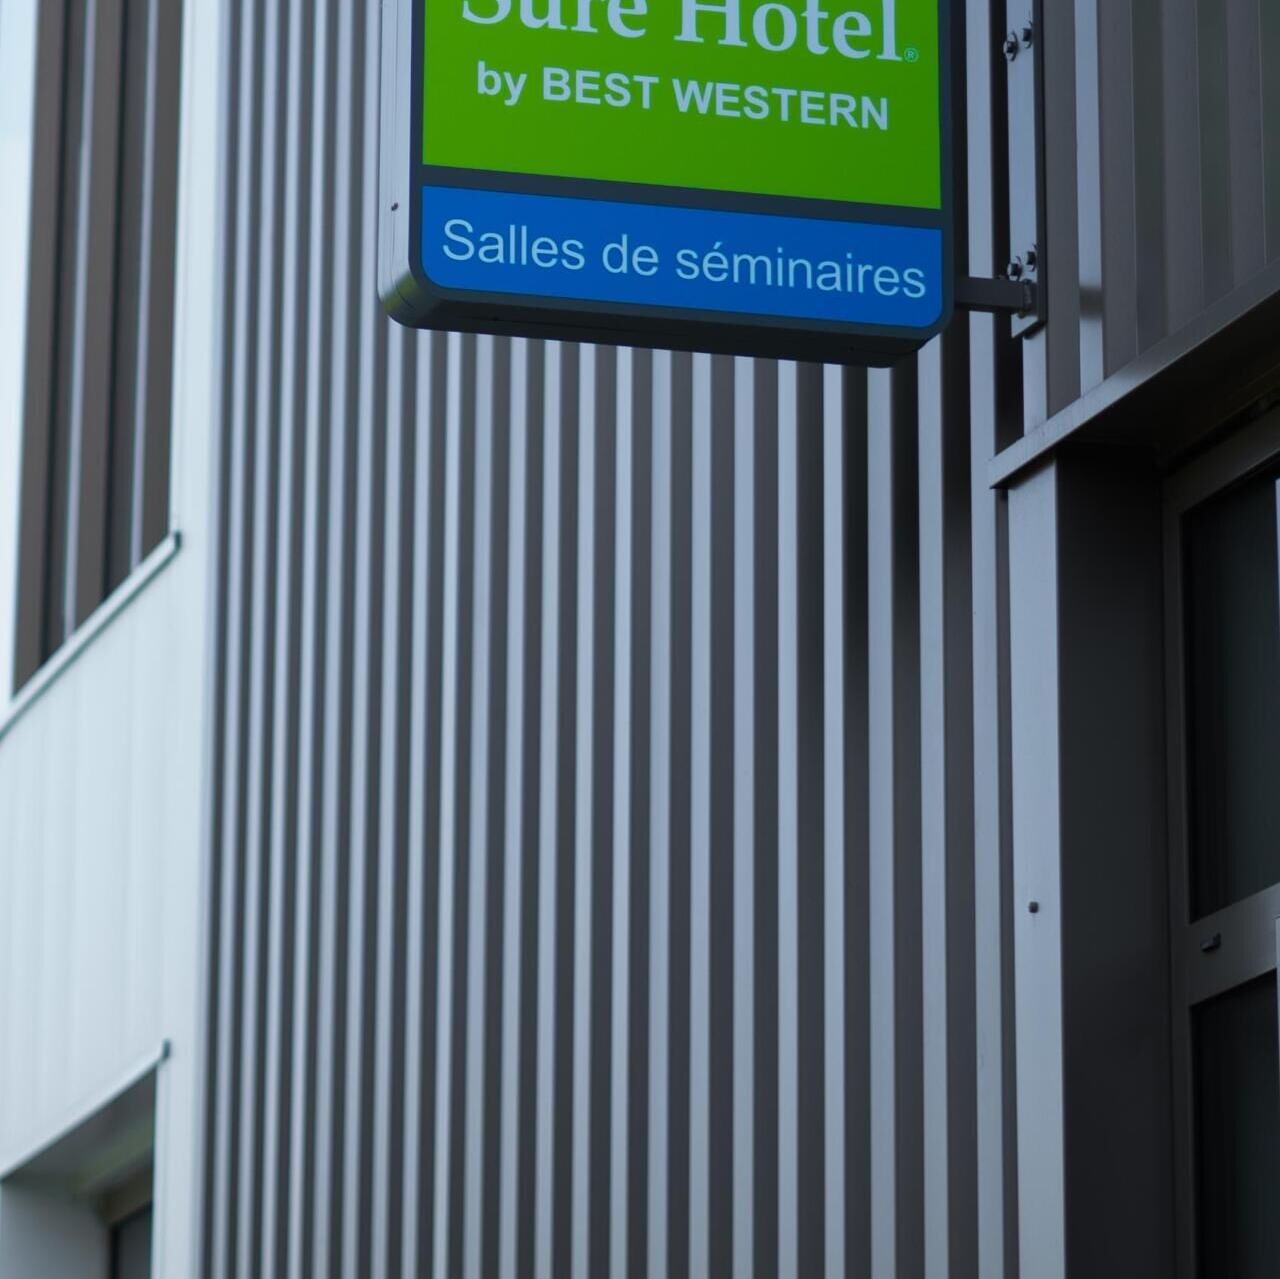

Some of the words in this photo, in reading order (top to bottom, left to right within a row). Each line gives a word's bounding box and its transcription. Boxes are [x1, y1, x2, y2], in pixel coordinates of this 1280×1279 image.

[476, 59, 528, 107] by
[542, 66, 660, 110] BEST
[671, 77, 889, 131] WESTERN
[442, 218, 586, 271] Salles
[601, 233, 660, 277] de
[676, 242, 926, 299] séminaires
